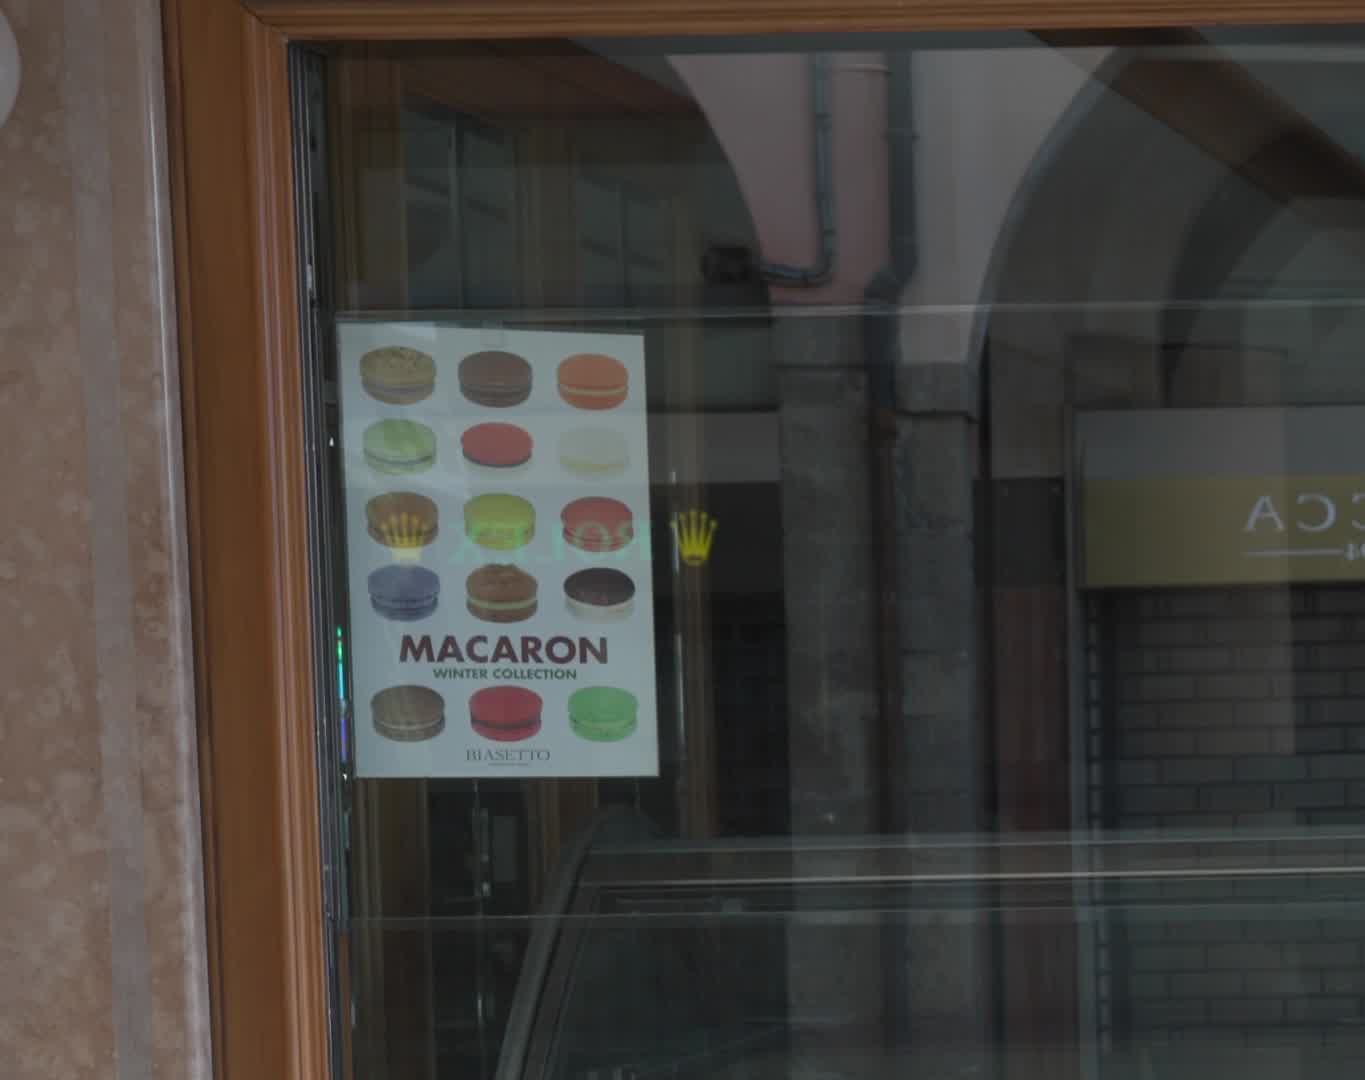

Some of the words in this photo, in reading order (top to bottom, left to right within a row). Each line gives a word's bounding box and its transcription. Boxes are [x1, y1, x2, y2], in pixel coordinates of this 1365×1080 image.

[399, 634, 609, 665] MACARON
[433, 668, 488, 680] WINTER
[493, 668, 577, 681] COLLECTION
[465, 748, 551, 762] BIASETTO
